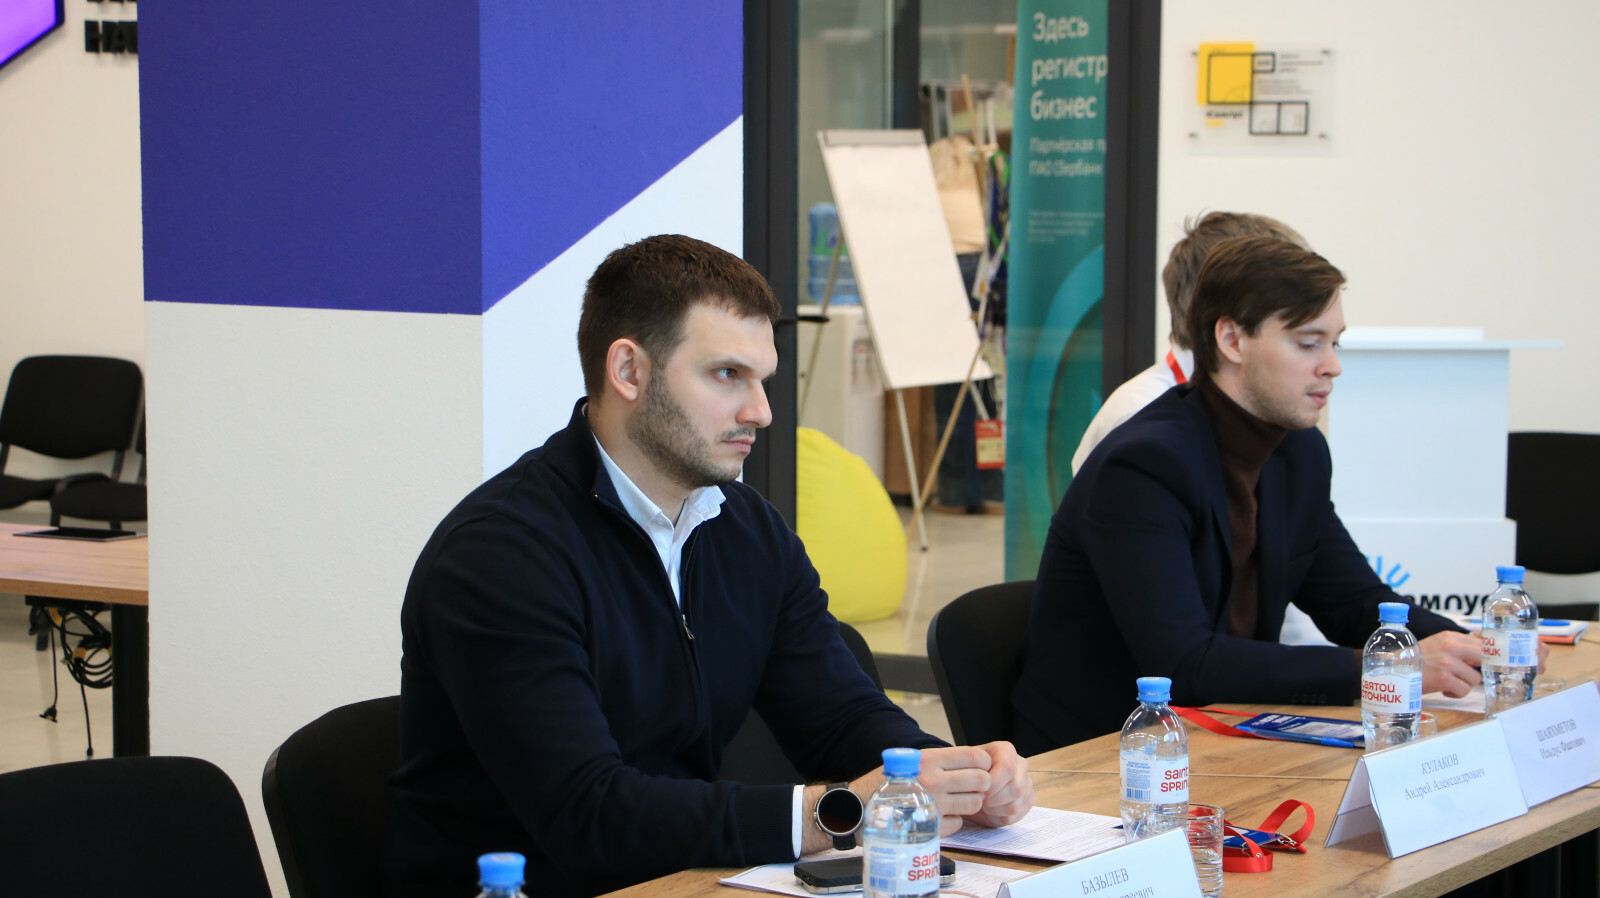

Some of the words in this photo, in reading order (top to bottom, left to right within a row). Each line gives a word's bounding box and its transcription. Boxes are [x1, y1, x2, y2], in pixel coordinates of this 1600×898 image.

[1032, 11, 1090, 45] Здесь
[1030, 89, 1098, 120] бизнес
[1421, 753, 1459, 775] КУЛАКОВ
[1405, 781, 1433, 800] Андрей
[1433, 767, 1486, 792] Александрович
[1080, 867, 1130, 895] БАЗЫЛЕВ
